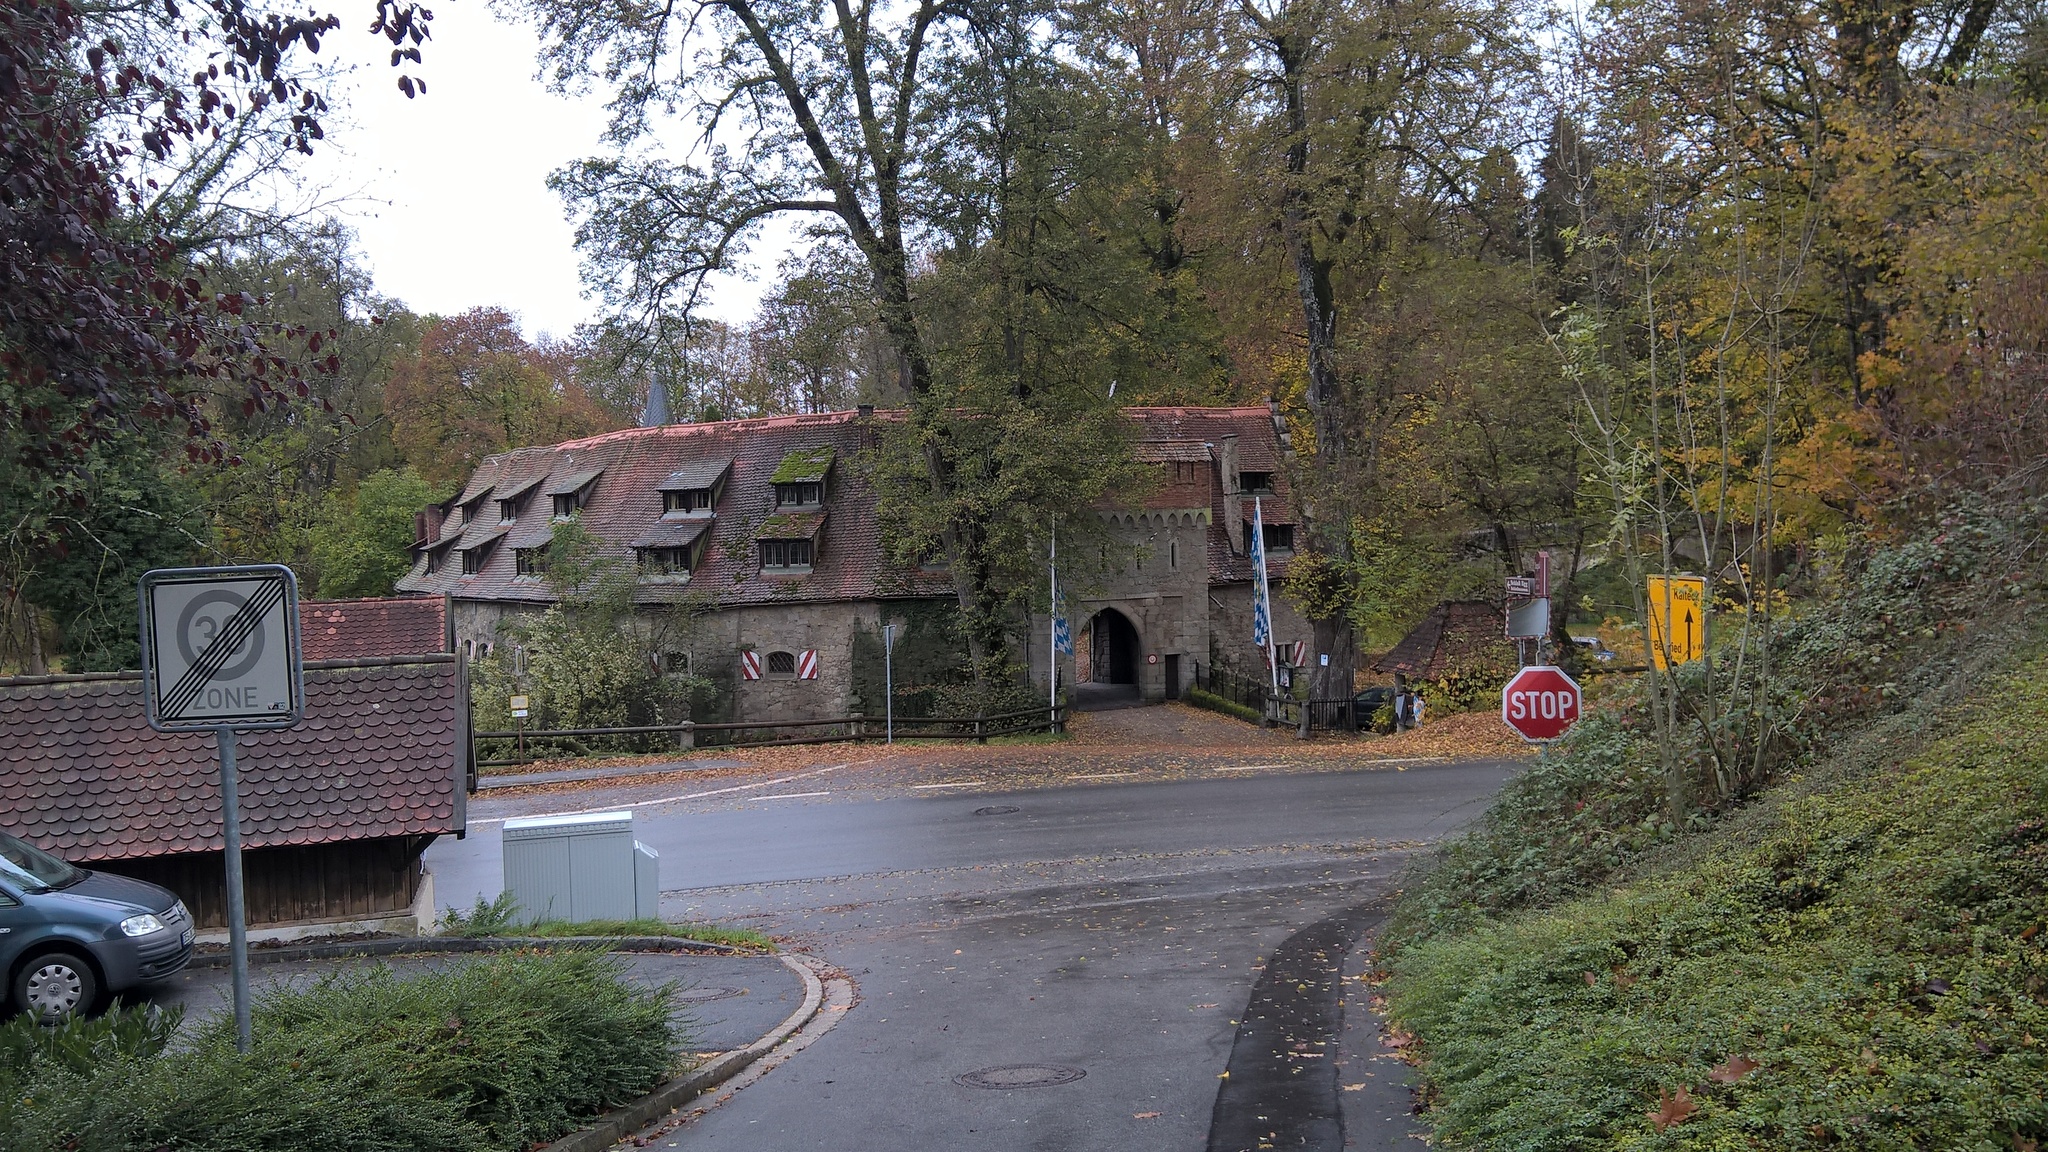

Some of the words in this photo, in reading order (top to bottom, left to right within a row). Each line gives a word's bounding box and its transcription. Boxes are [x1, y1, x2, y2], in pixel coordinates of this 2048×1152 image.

[194, 614, 246, 655] 30
[1653, 640, 1682, 653] Beied
[192, 687, 258, 710] ZONE
[1511, 691, 1573, 719] STOP
